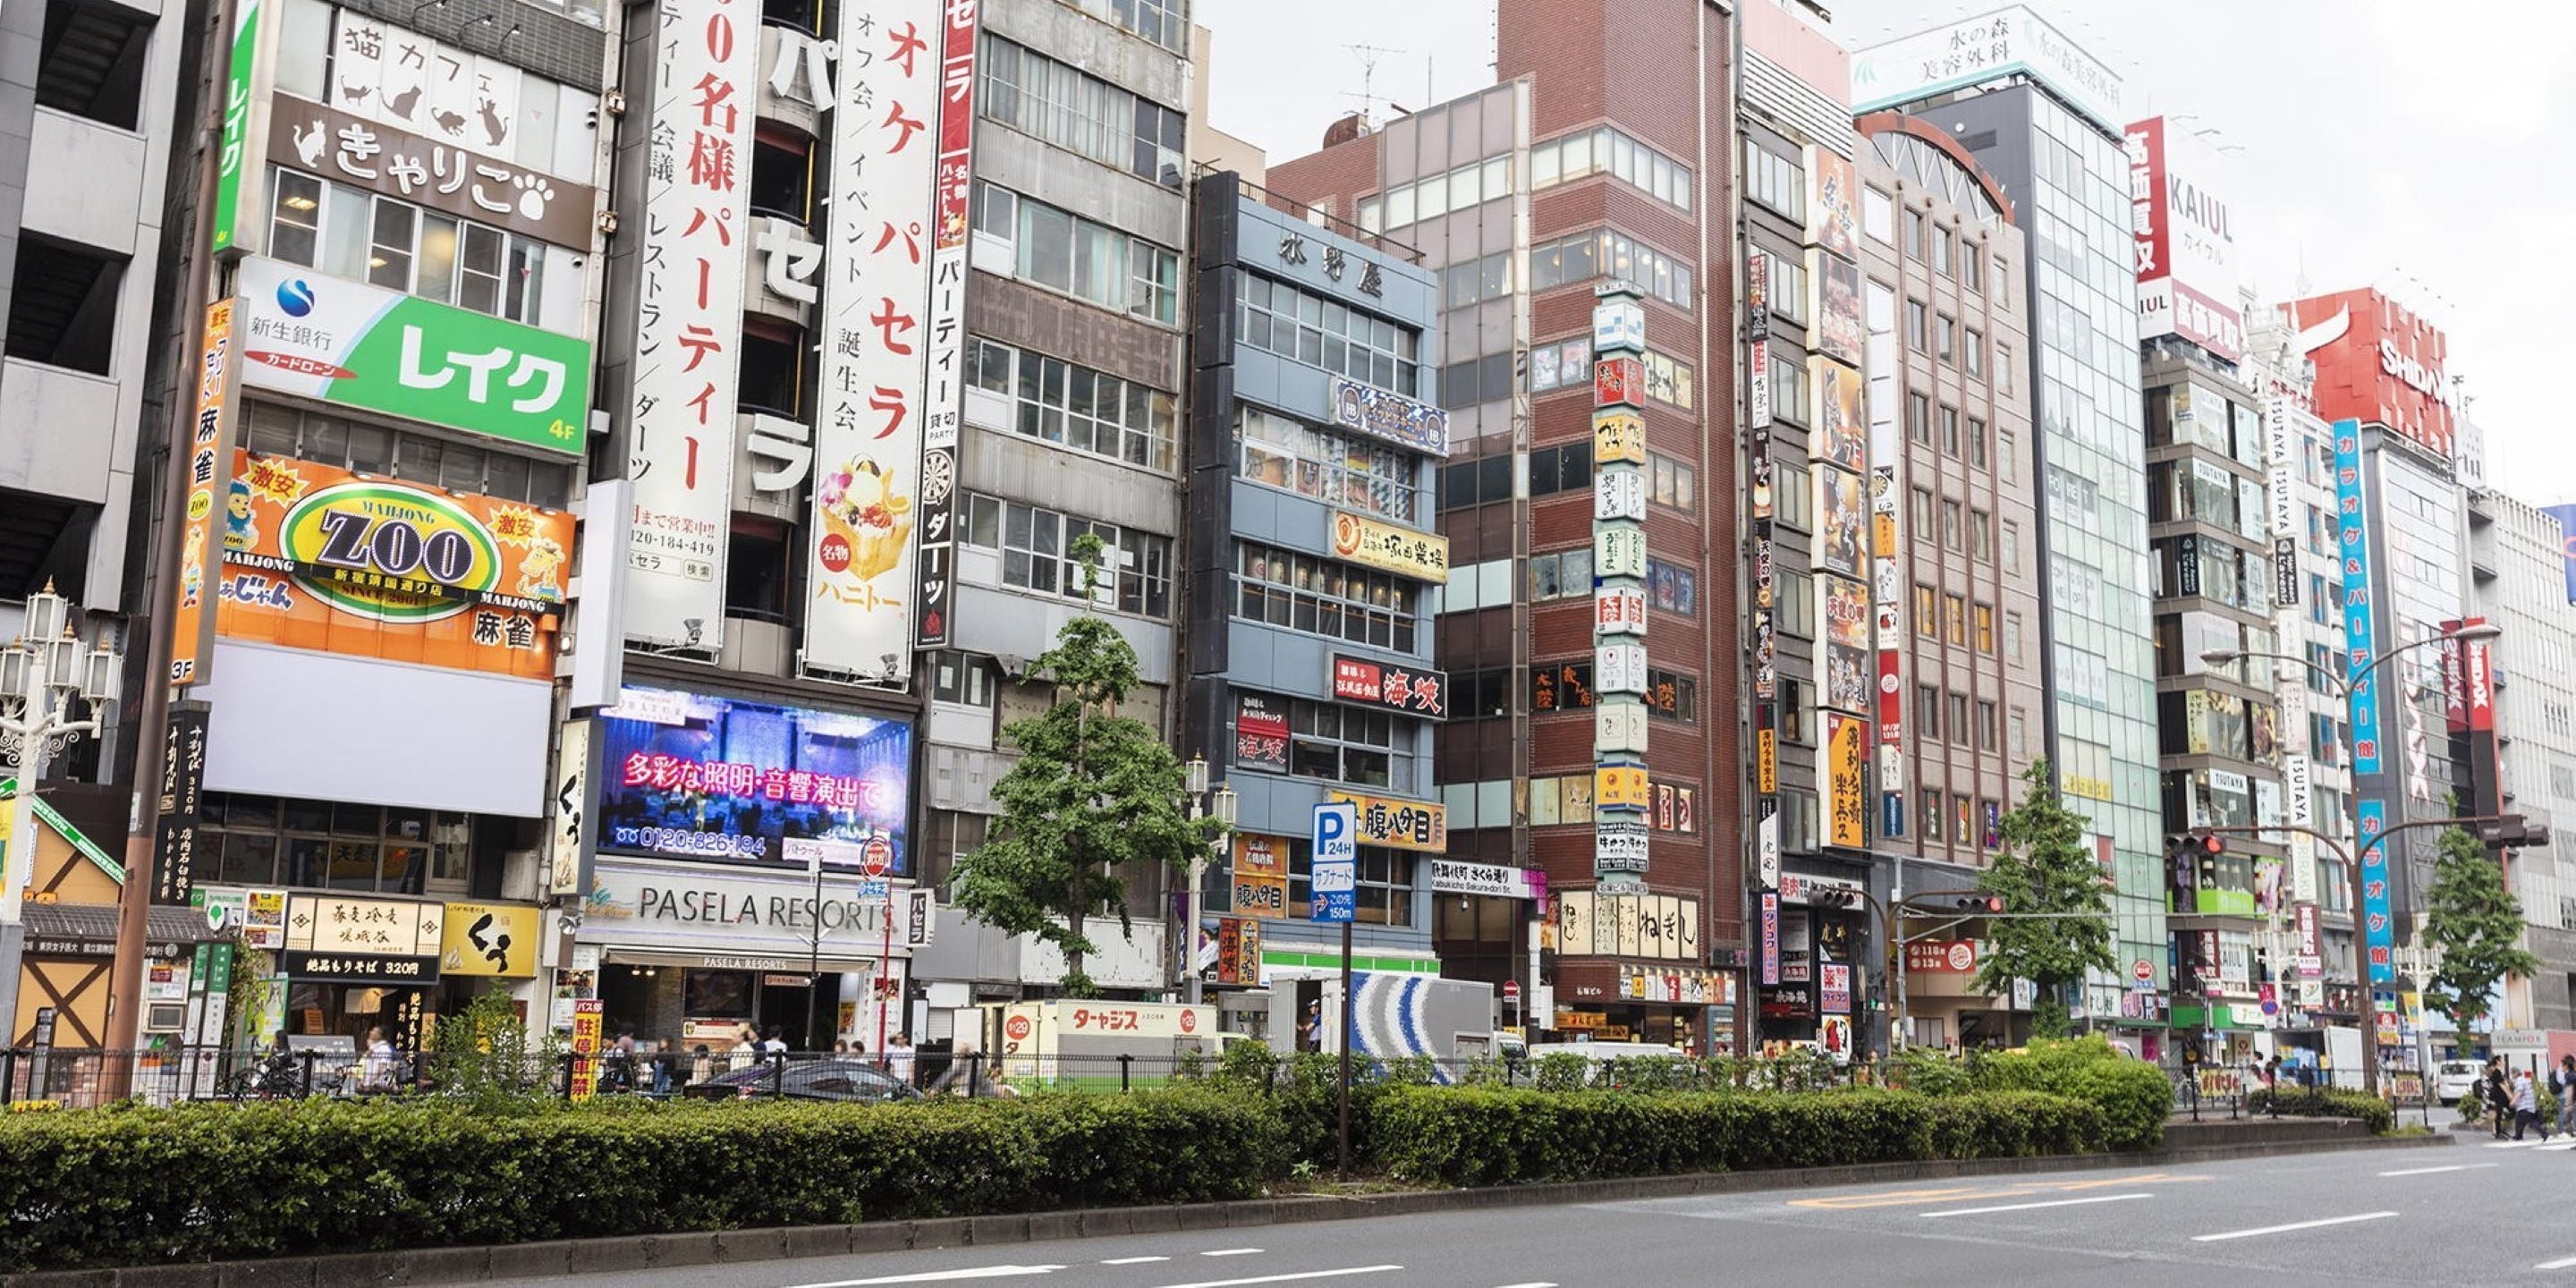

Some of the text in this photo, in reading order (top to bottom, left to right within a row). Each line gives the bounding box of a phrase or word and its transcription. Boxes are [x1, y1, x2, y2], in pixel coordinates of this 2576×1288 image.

[1948, 17, 2011, 52] 水の森
[344, 26, 493, 93] 猫カフェ
[1920, 39, 2011, 82] 美容外科
[222, 78, 249, 178] レイク
[336, 123, 513, 214] きゃりこ
[2169, 172, 2233, 244] KAIUL
[677, 0, 740, 491] 0名様パーティー
[2183, 230, 2224, 266] カイウル
[251, 315, 333, 352] 新生銀行
[936, 260, 961, 402] パーティー
[267, 352, 336, 376] カードローン
[398, 324, 567, 414] レイク
[548, 419, 575, 440] 4F
[929, 430, 955, 440] PARTY
[930, 411, 955, 429] 貸切
[2270, 401, 2285, 460] TSUTAYA
[191, 407, 219, 486] 麻雀
[2198, 462, 2227, 484] TSUTAYA
[360, 500, 436, 526] MAHJONG
[2275, 470, 2291, 530] TSUTAYA
[220, 550, 295, 574] MAHJONG
[318, 508, 476, 586] ZOO
[821, 544, 850, 562] 名物
[924, 512, 949, 606] ダーツ
[334, 570, 445, 597] 新宿靖国通り店
[480, 590, 547, 613] MAHJONG
[818, 581, 902, 613] ハニトー
[473, 611, 535, 648] 麻雀
[171, 662, 193, 682] 3F
[1384, 669, 1443, 715] 海峡
[2215, 773, 2244, 790] TSUTAYA
[2292, 758, 2306, 821] TSUTAYA
[1318, 811, 1352, 856] P 24H
[1365, 802, 1431, 843] 腹八分目
[640, 826, 767, 856] 0120-826-194
[1315, 869, 1352, 886] サブナード
[1470, 866, 1509, 884] さくら通り
[2362, 815, 2391, 968] カラオケ館
[640, 887, 758, 925] PASELA
[768, 897, 895, 932] RESORTS
[1236, 884, 1282, 909] 腹八分目
[1330, 908, 1352, 919] 150m
[912, 898, 926, 942] パセラ
[1639, 909, 1697, 945] ねぎし
[306, 958, 420, 976] 絶品もりそば 320円
[704, 957, 787, 969] PASELA RESORTS
[572, 1019, 593, 1102] 駐停車禁
